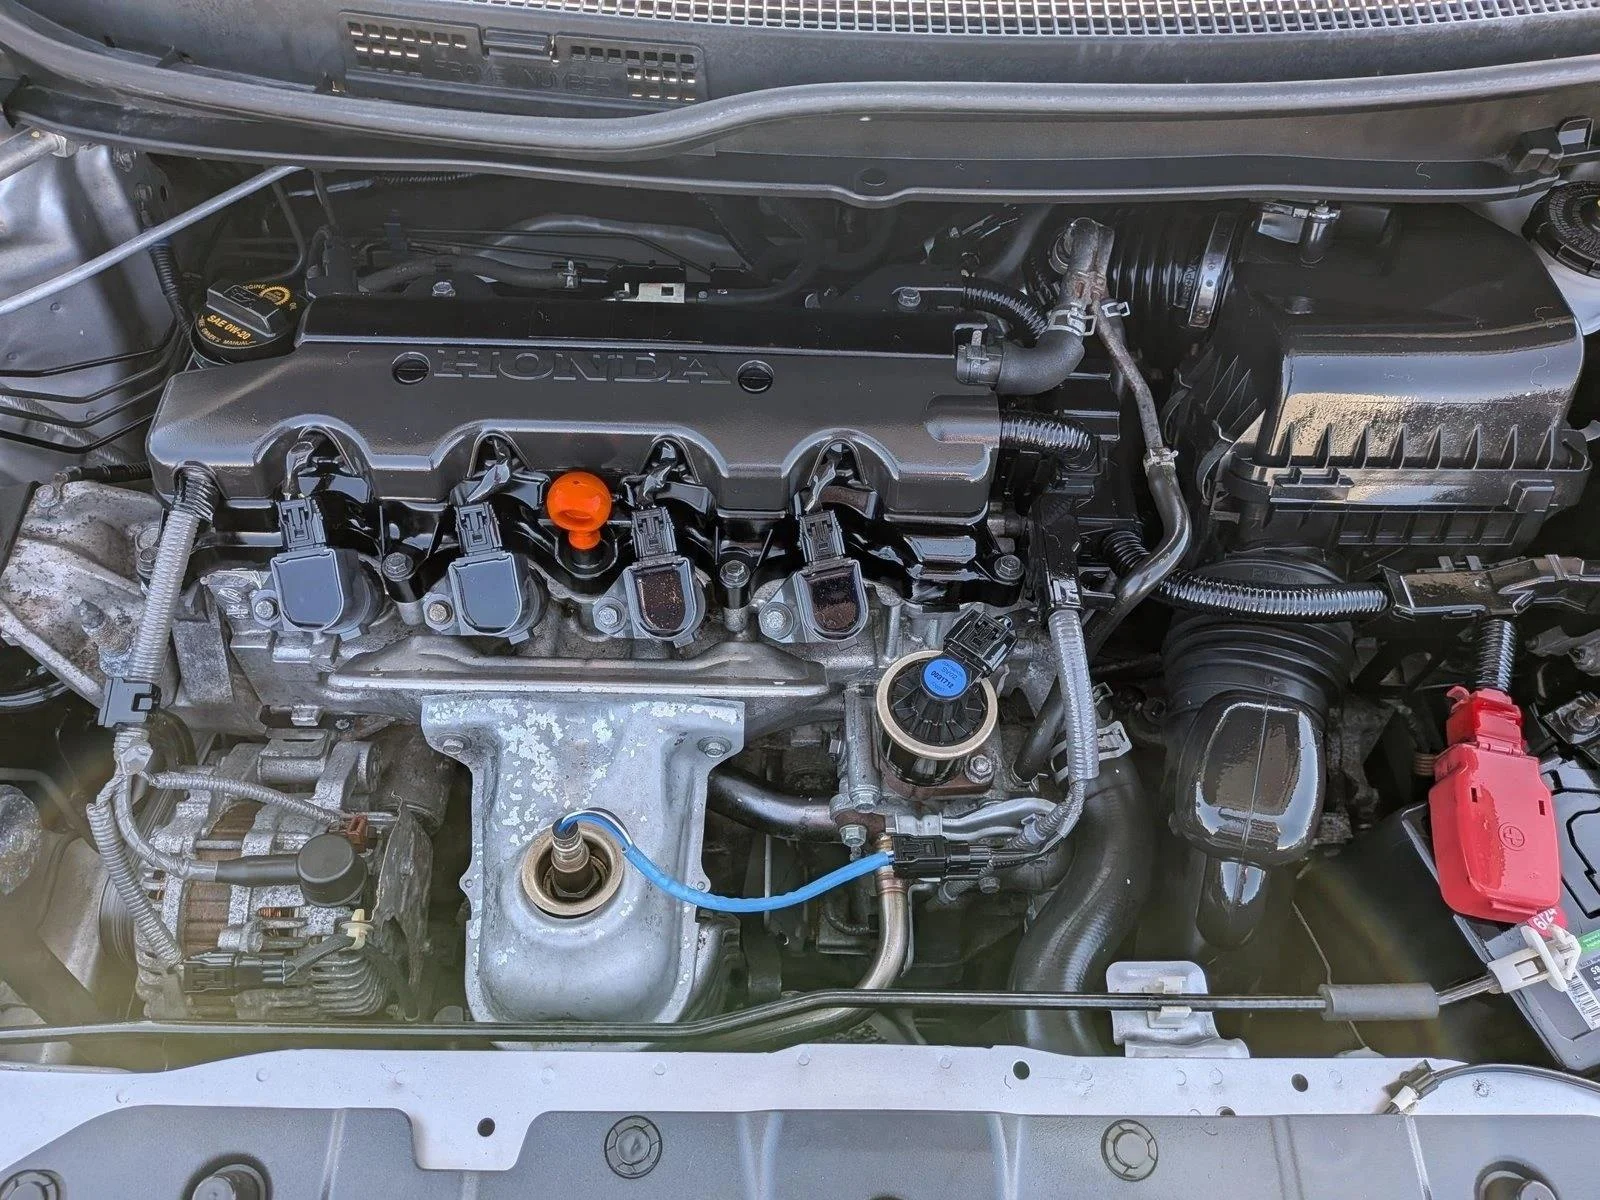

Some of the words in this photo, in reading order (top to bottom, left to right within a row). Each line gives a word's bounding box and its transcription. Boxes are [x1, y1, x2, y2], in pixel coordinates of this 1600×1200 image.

[523, 67, 612, 93] NUMBER
[208, 315, 228, 328] SAE
[225, 324, 251, 340] 0W-20
[433, 349, 732, 385] HONDA
